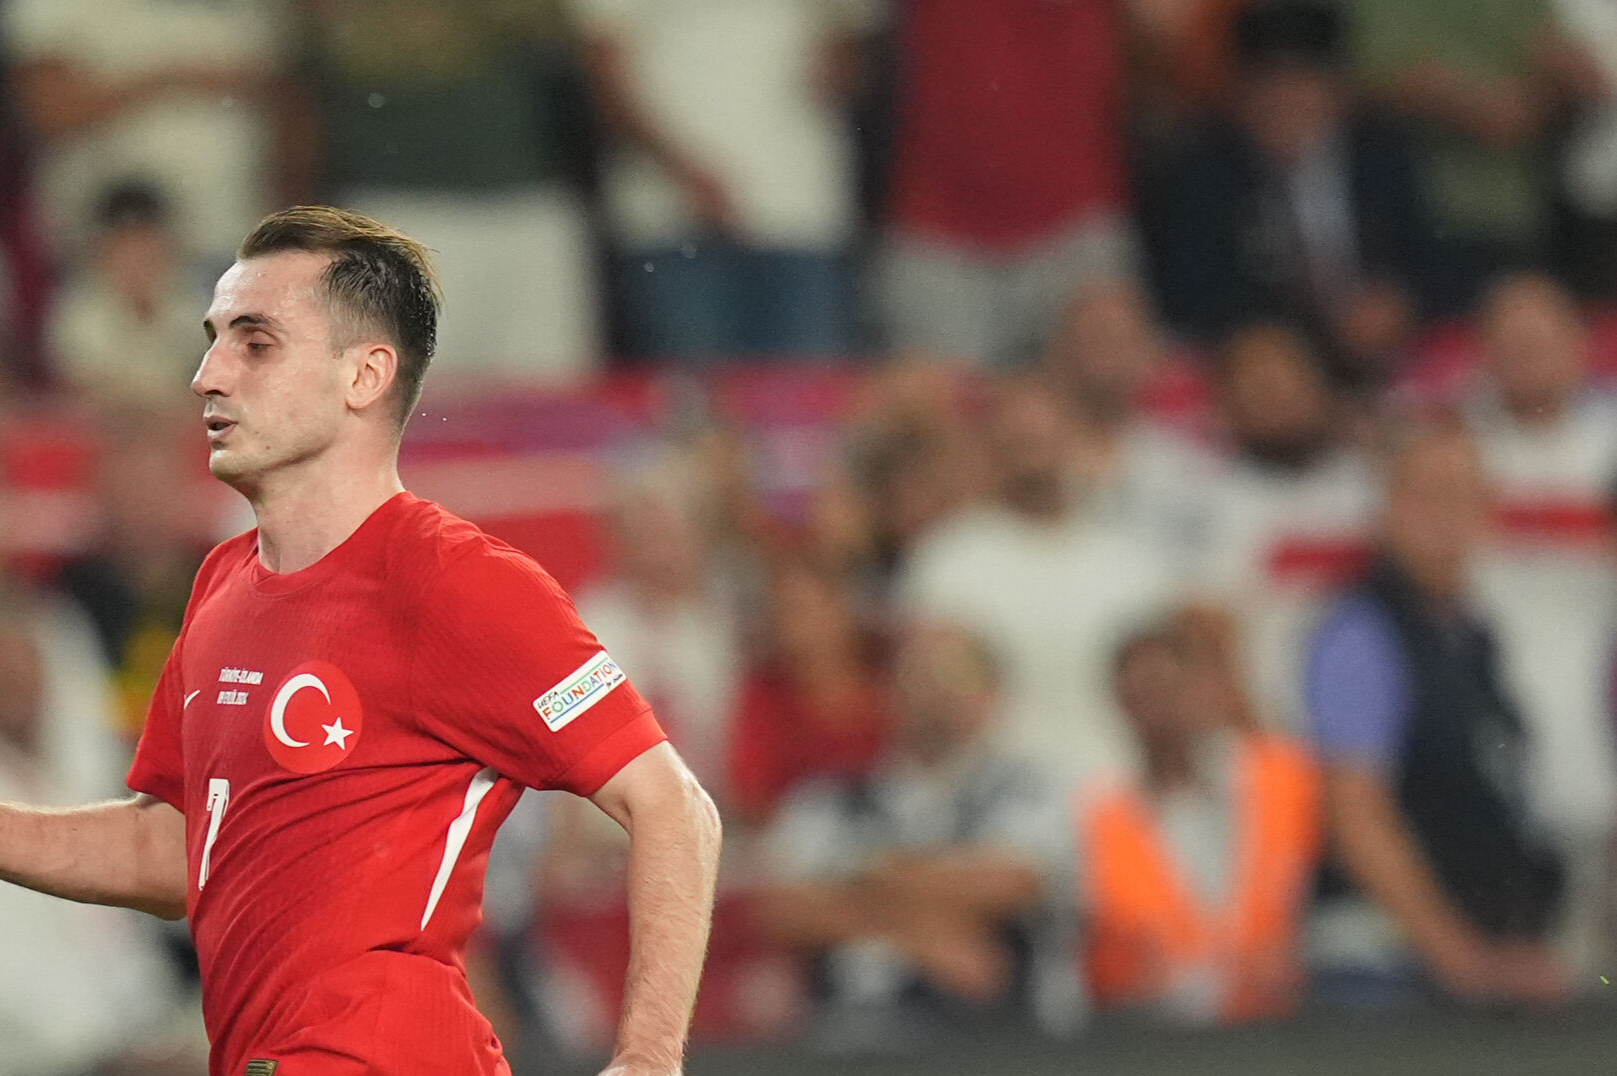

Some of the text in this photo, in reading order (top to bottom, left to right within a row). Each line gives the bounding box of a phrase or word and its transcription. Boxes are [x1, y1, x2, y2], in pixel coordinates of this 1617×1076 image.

[537, 691, 558, 709] UEFA
[543, 661, 617, 719] FOUNDATION
[198, 778, 230, 891] 7
